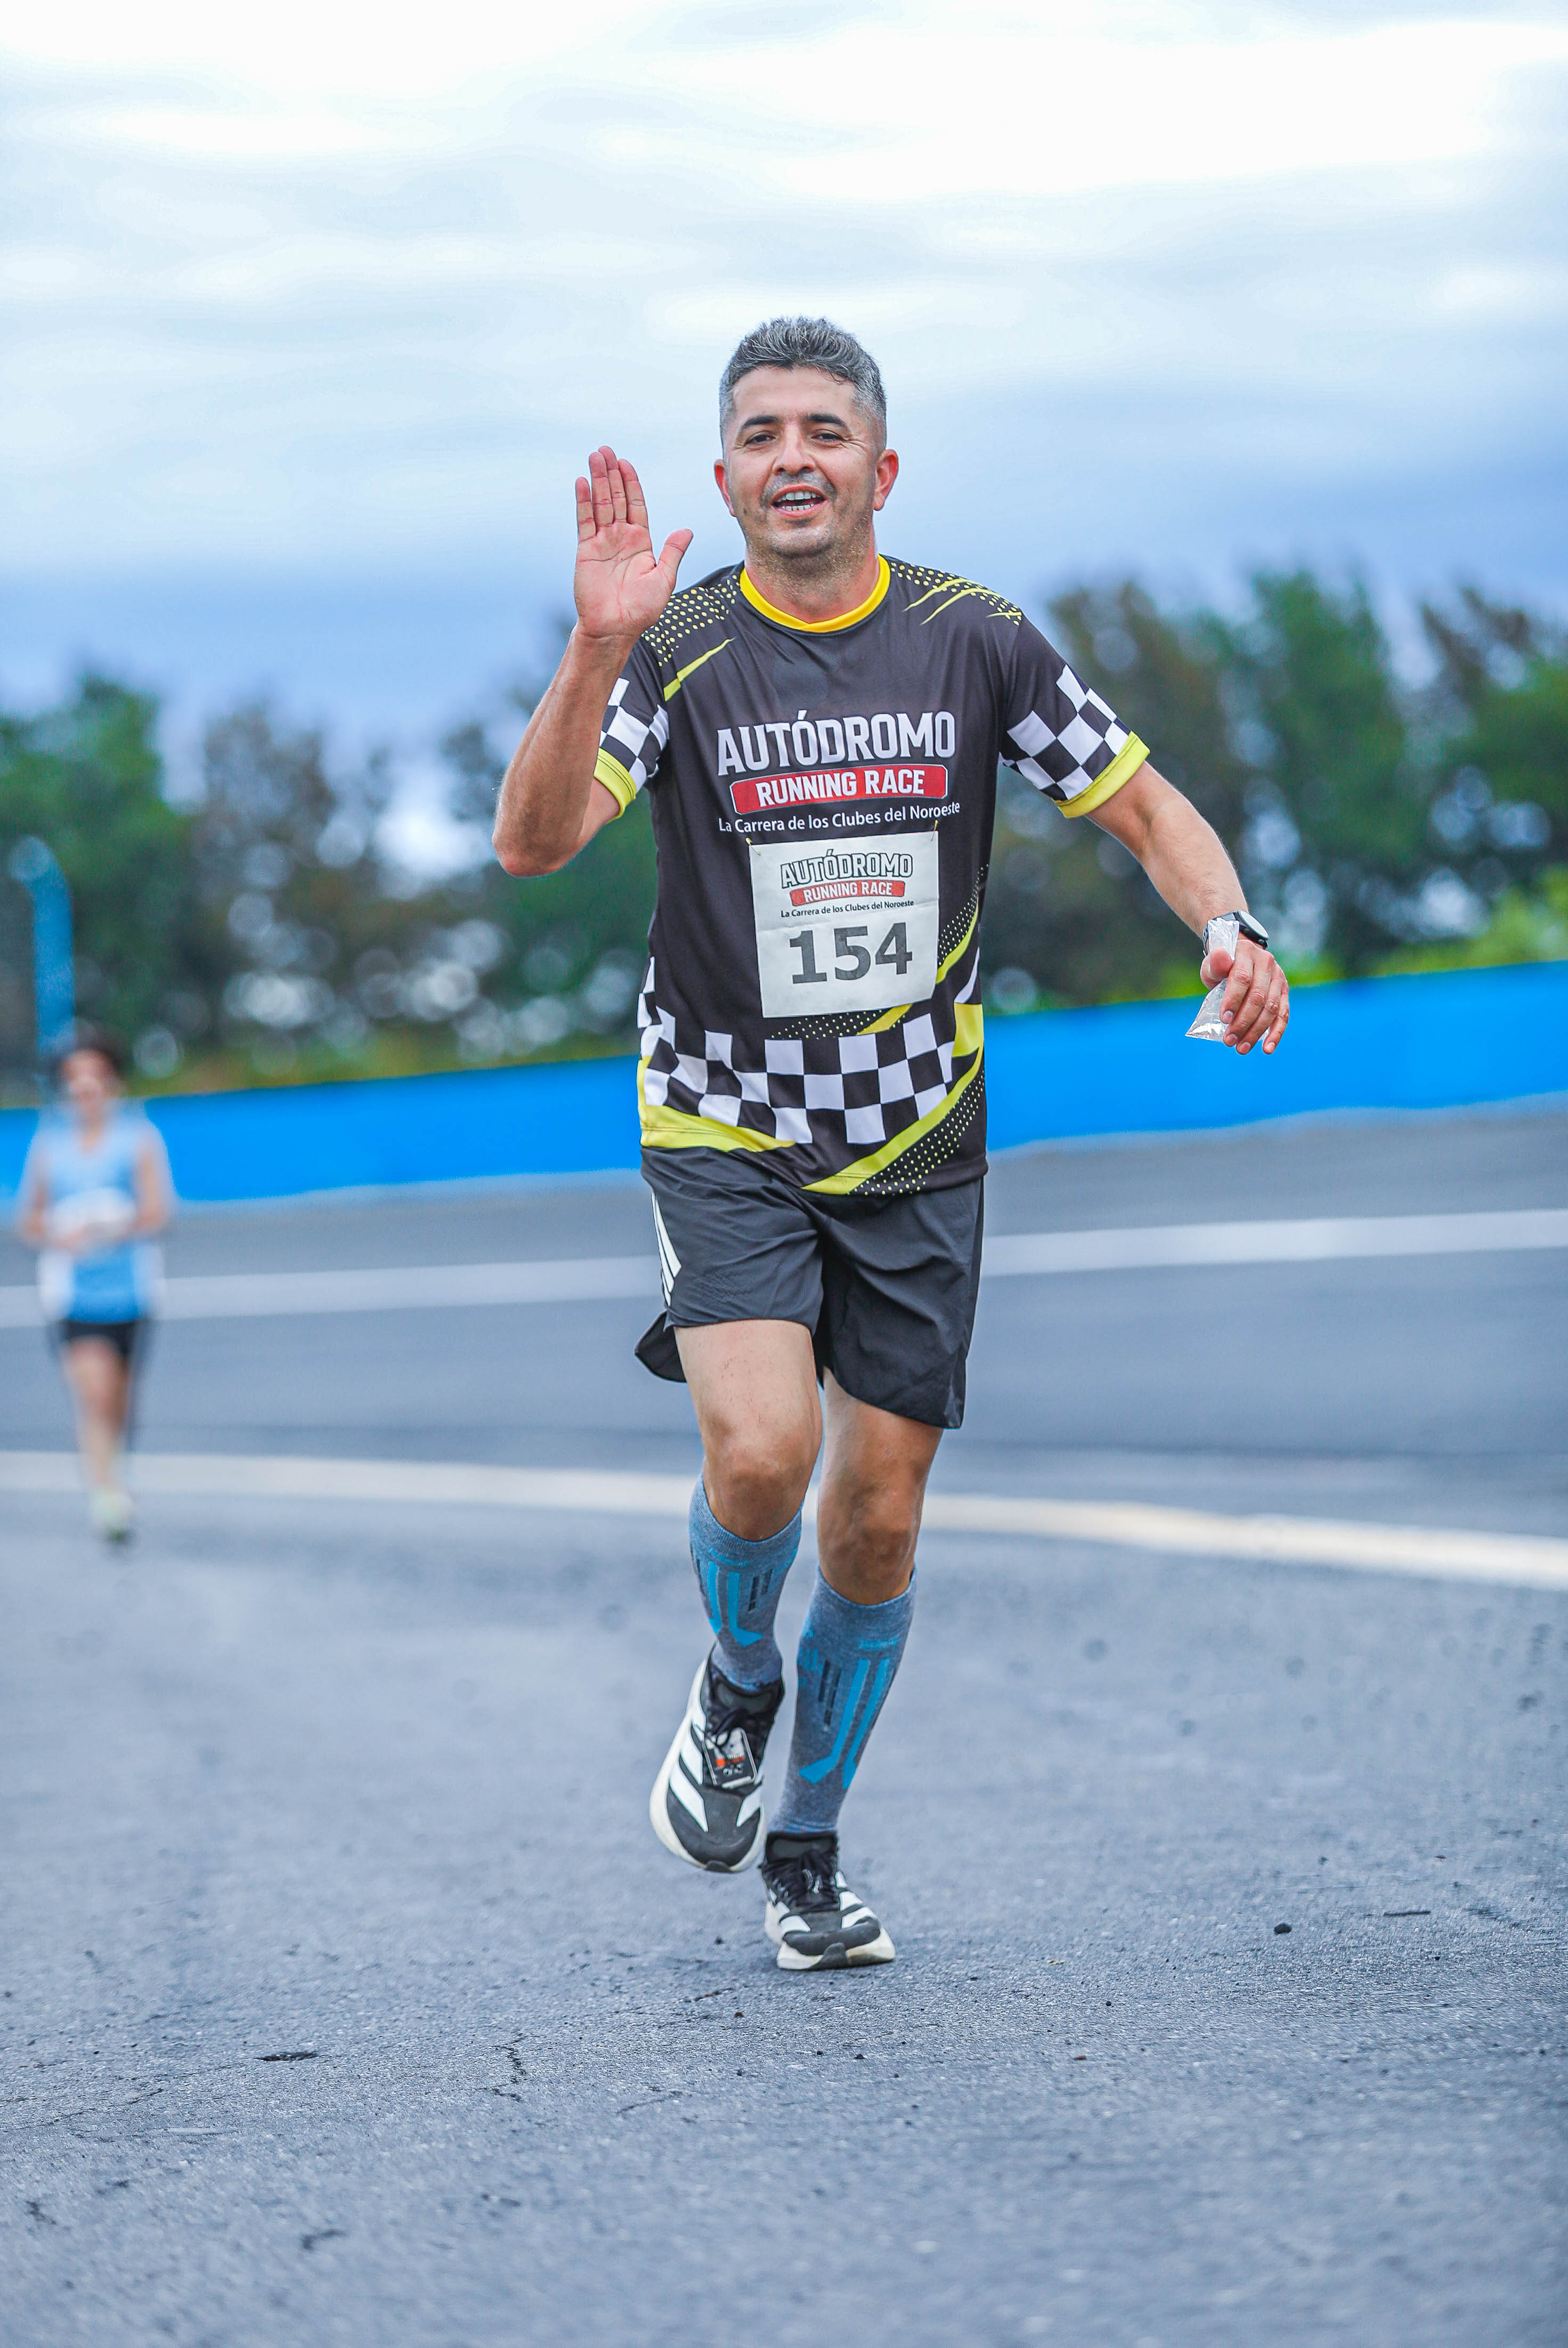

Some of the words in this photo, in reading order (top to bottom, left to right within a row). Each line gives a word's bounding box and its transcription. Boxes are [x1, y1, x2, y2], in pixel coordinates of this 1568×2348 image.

[717, 709, 955, 776] AUTÓDROMO
[754, 769, 858, 808] RUNNING
[864, 769, 926, 795] RACE
[718, 817, 733, 832] La
[734, 819, 785, 833] Carrera
[788, 815, 806, 831] de
[808, 814, 829, 829] los
[832, 811, 881, 827] Clubes
[884, 806, 906, 822] del
[909, 801, 961, 820] Noroeste
[779, 848, 913, 889] AUTÓDROMO
[803, 881, 858, 903] RUNNING
[860, 881, 893, 896] RACE
[871, 901, 883, 909] del
[884, 899, 915, 908] Noroeste
[789, 921, 913, 985] 154
